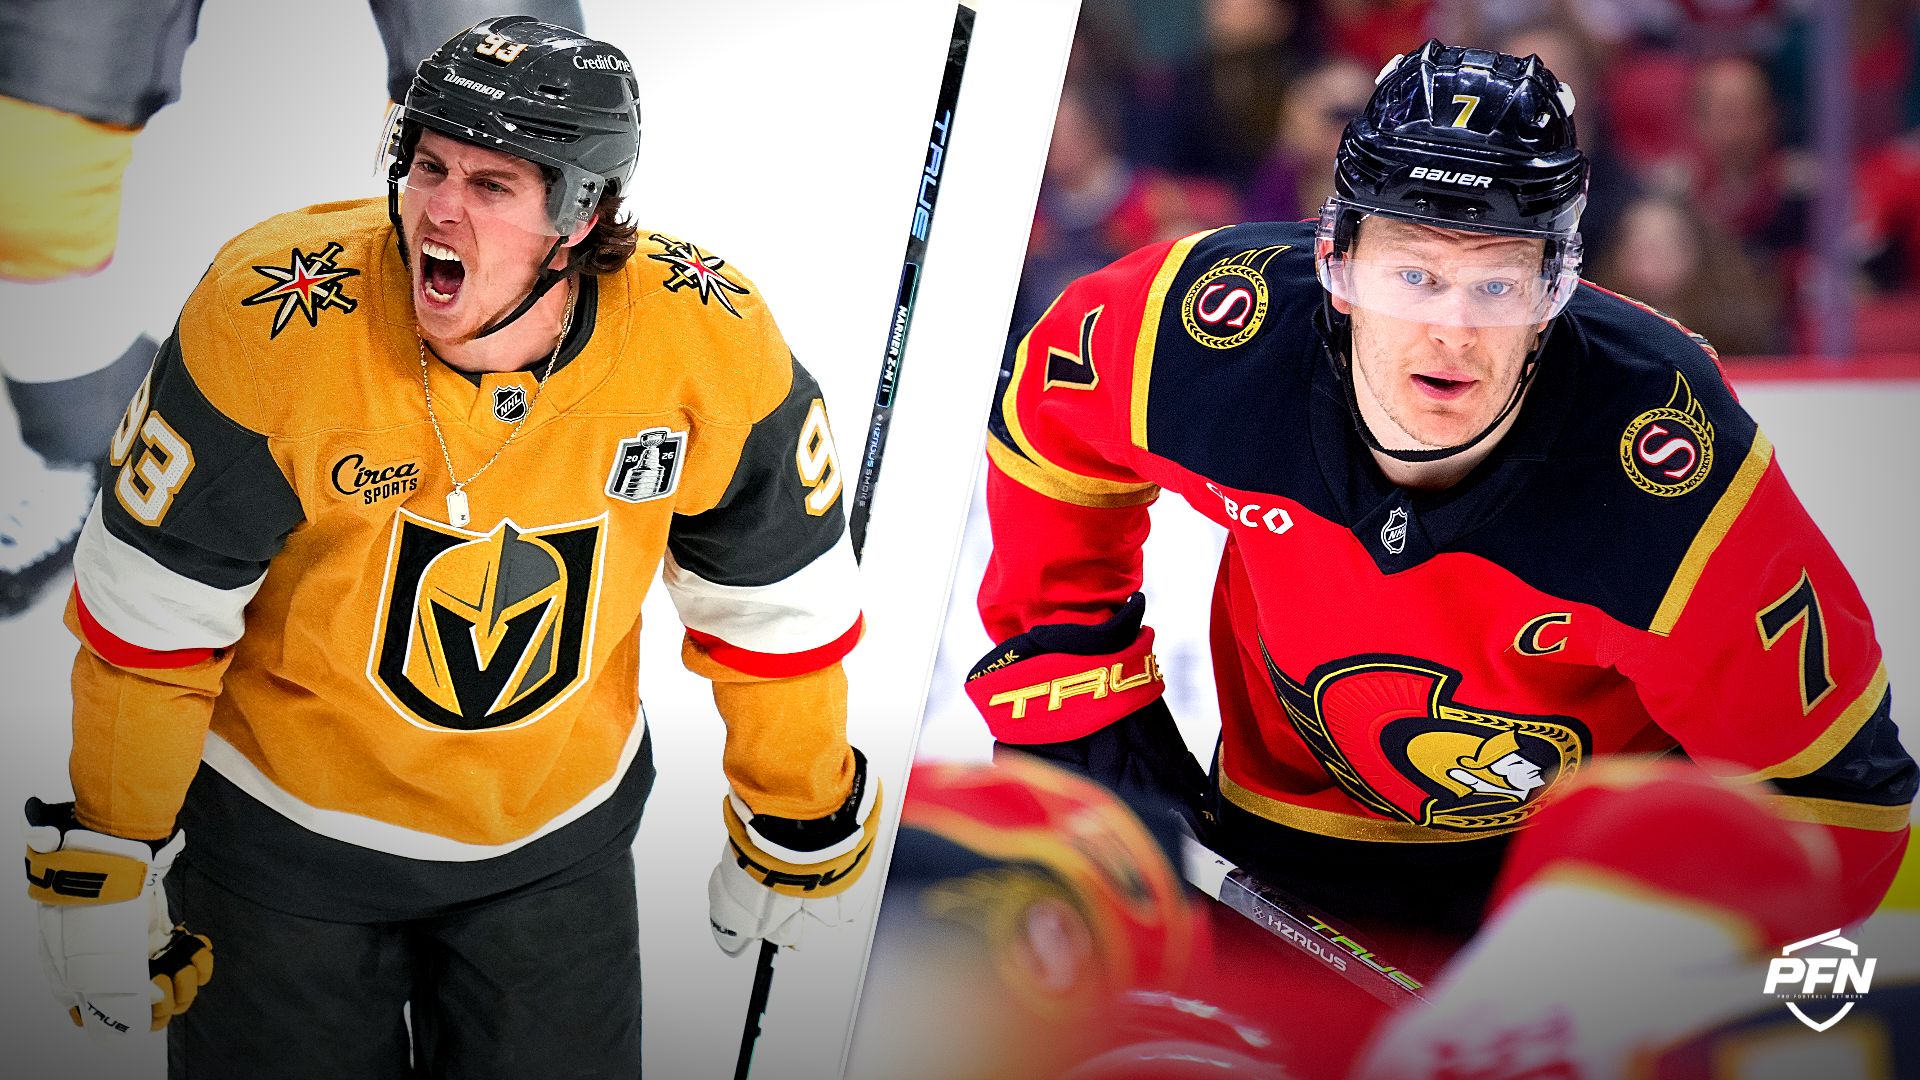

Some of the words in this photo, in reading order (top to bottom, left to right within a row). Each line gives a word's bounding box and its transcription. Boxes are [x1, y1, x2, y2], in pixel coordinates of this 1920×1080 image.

[476, 33, 528, 62] 93
[443, 73, 505, 99] WARRIOR
[1451, 94, 1481, 129] 7
[911, 109, 951, 242] TRUE
[1197, 283, 1253, 329] S
[889, 305, 908, 356] MARNER
[1044, 303, 1105, 392] 7
[500, 394, 521, 417] NHL
[332, 453, 420, 495] Circa
[625, 455, 639, 463] 20
[661, 451, 675, 460] 26
[1638, 424, 1697, 480] S
[364, 477, 419, 505] SPORTS
[1513, 612, 1573, 656] C
[1755, 566, 1838, 717] 7
[1268, 914, 1347, 973] HZRDUS
[1307, 914, 1424, 991] TRUE
[87, 1002, 130, 1033] TRUE
